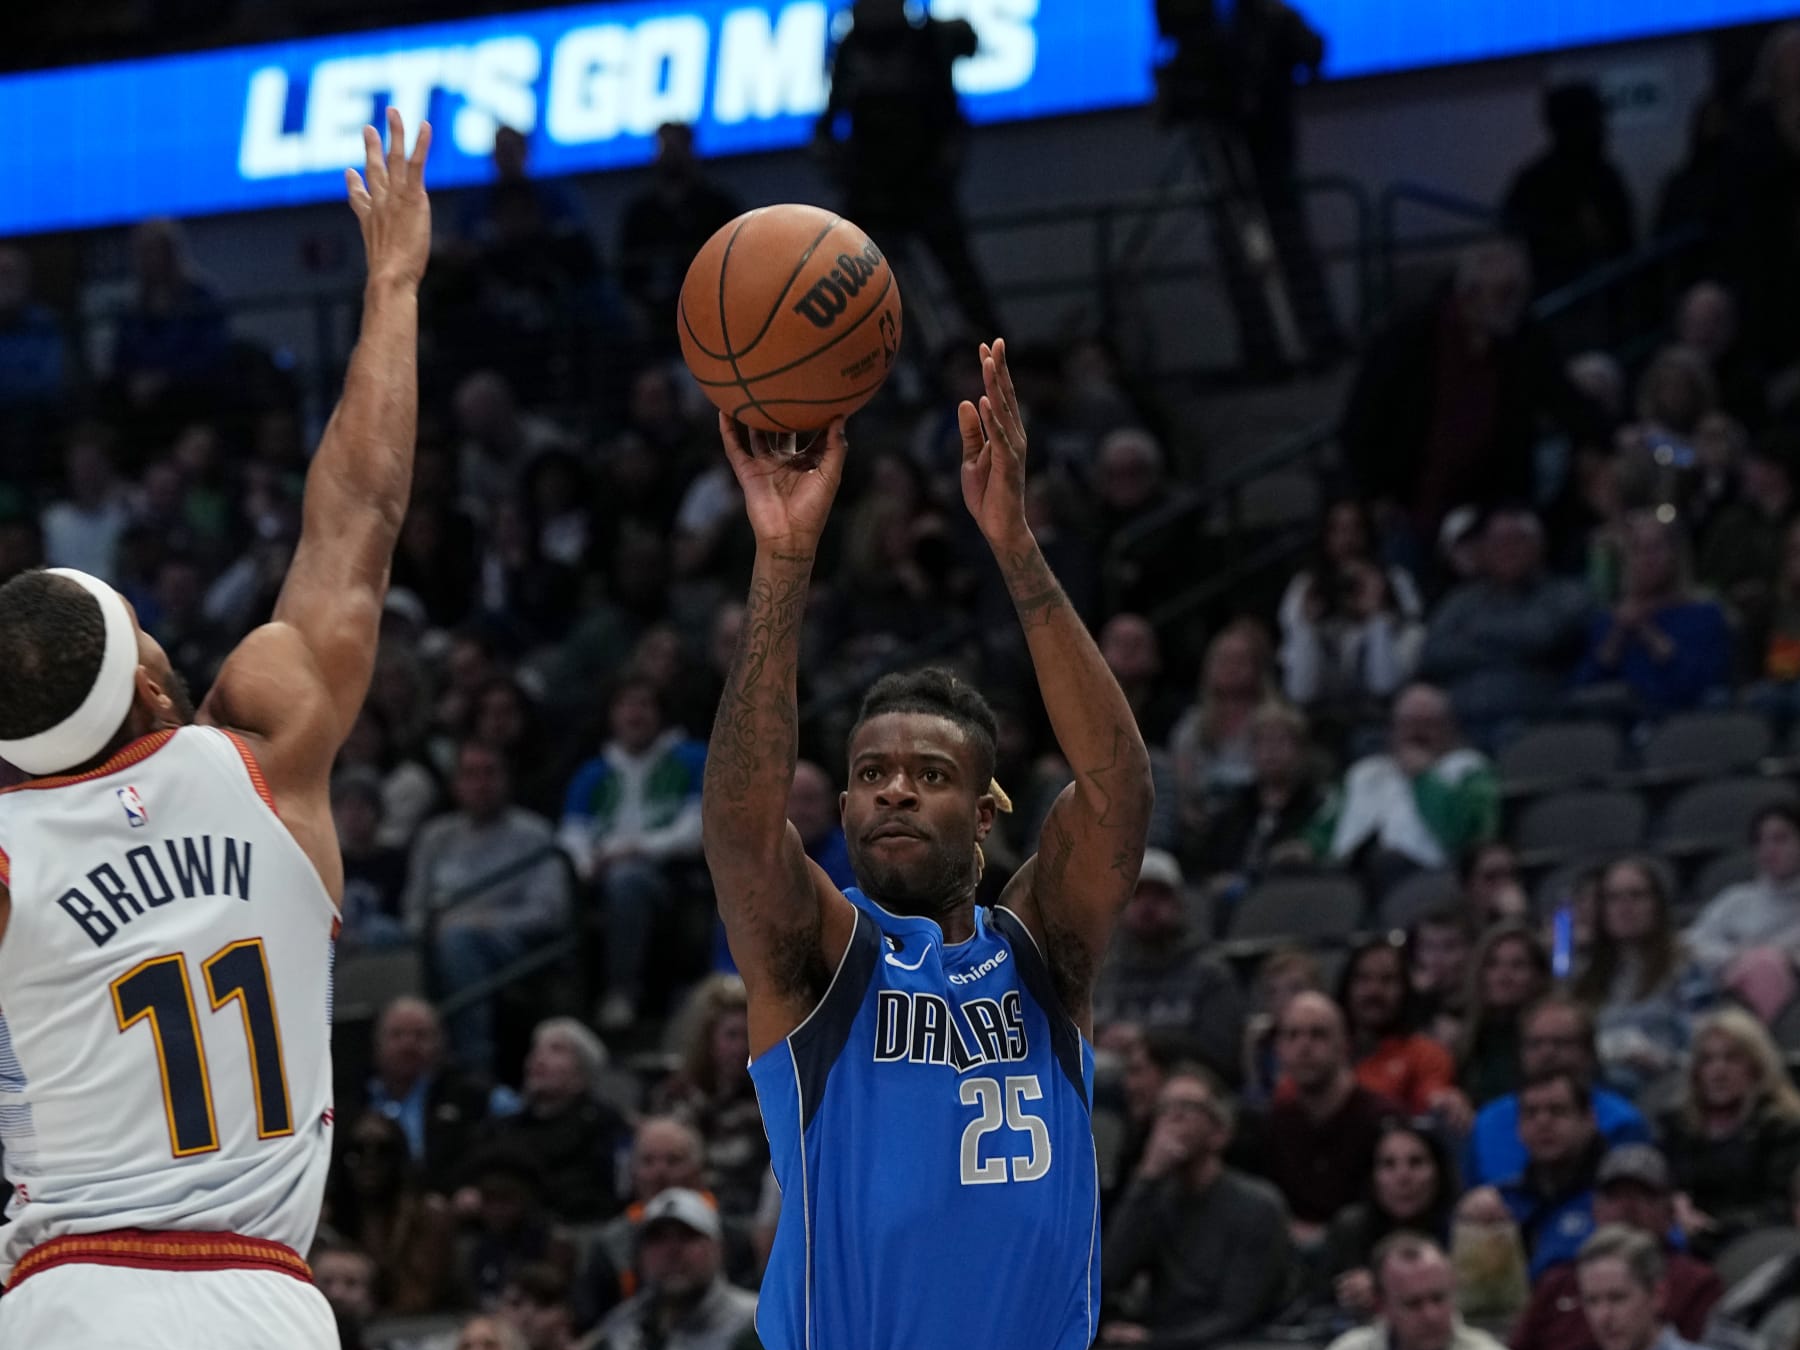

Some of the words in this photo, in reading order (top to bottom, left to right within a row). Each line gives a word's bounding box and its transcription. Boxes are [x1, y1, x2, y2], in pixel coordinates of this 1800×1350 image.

[238, 36, 541, 180] LET'S
[546, 22, 711, 144] GO
[713, 0, 1041, 124] MS
[792, 240, 883, 329] Wilso
[57, 834, 252, 947] BROWN
[949, 949, 1009, 986] chime
[109, 936, 295, 1159] 11
[873, 990, 1028, 1074] DALAS
[959, 1075, 1051, 1185] 25
